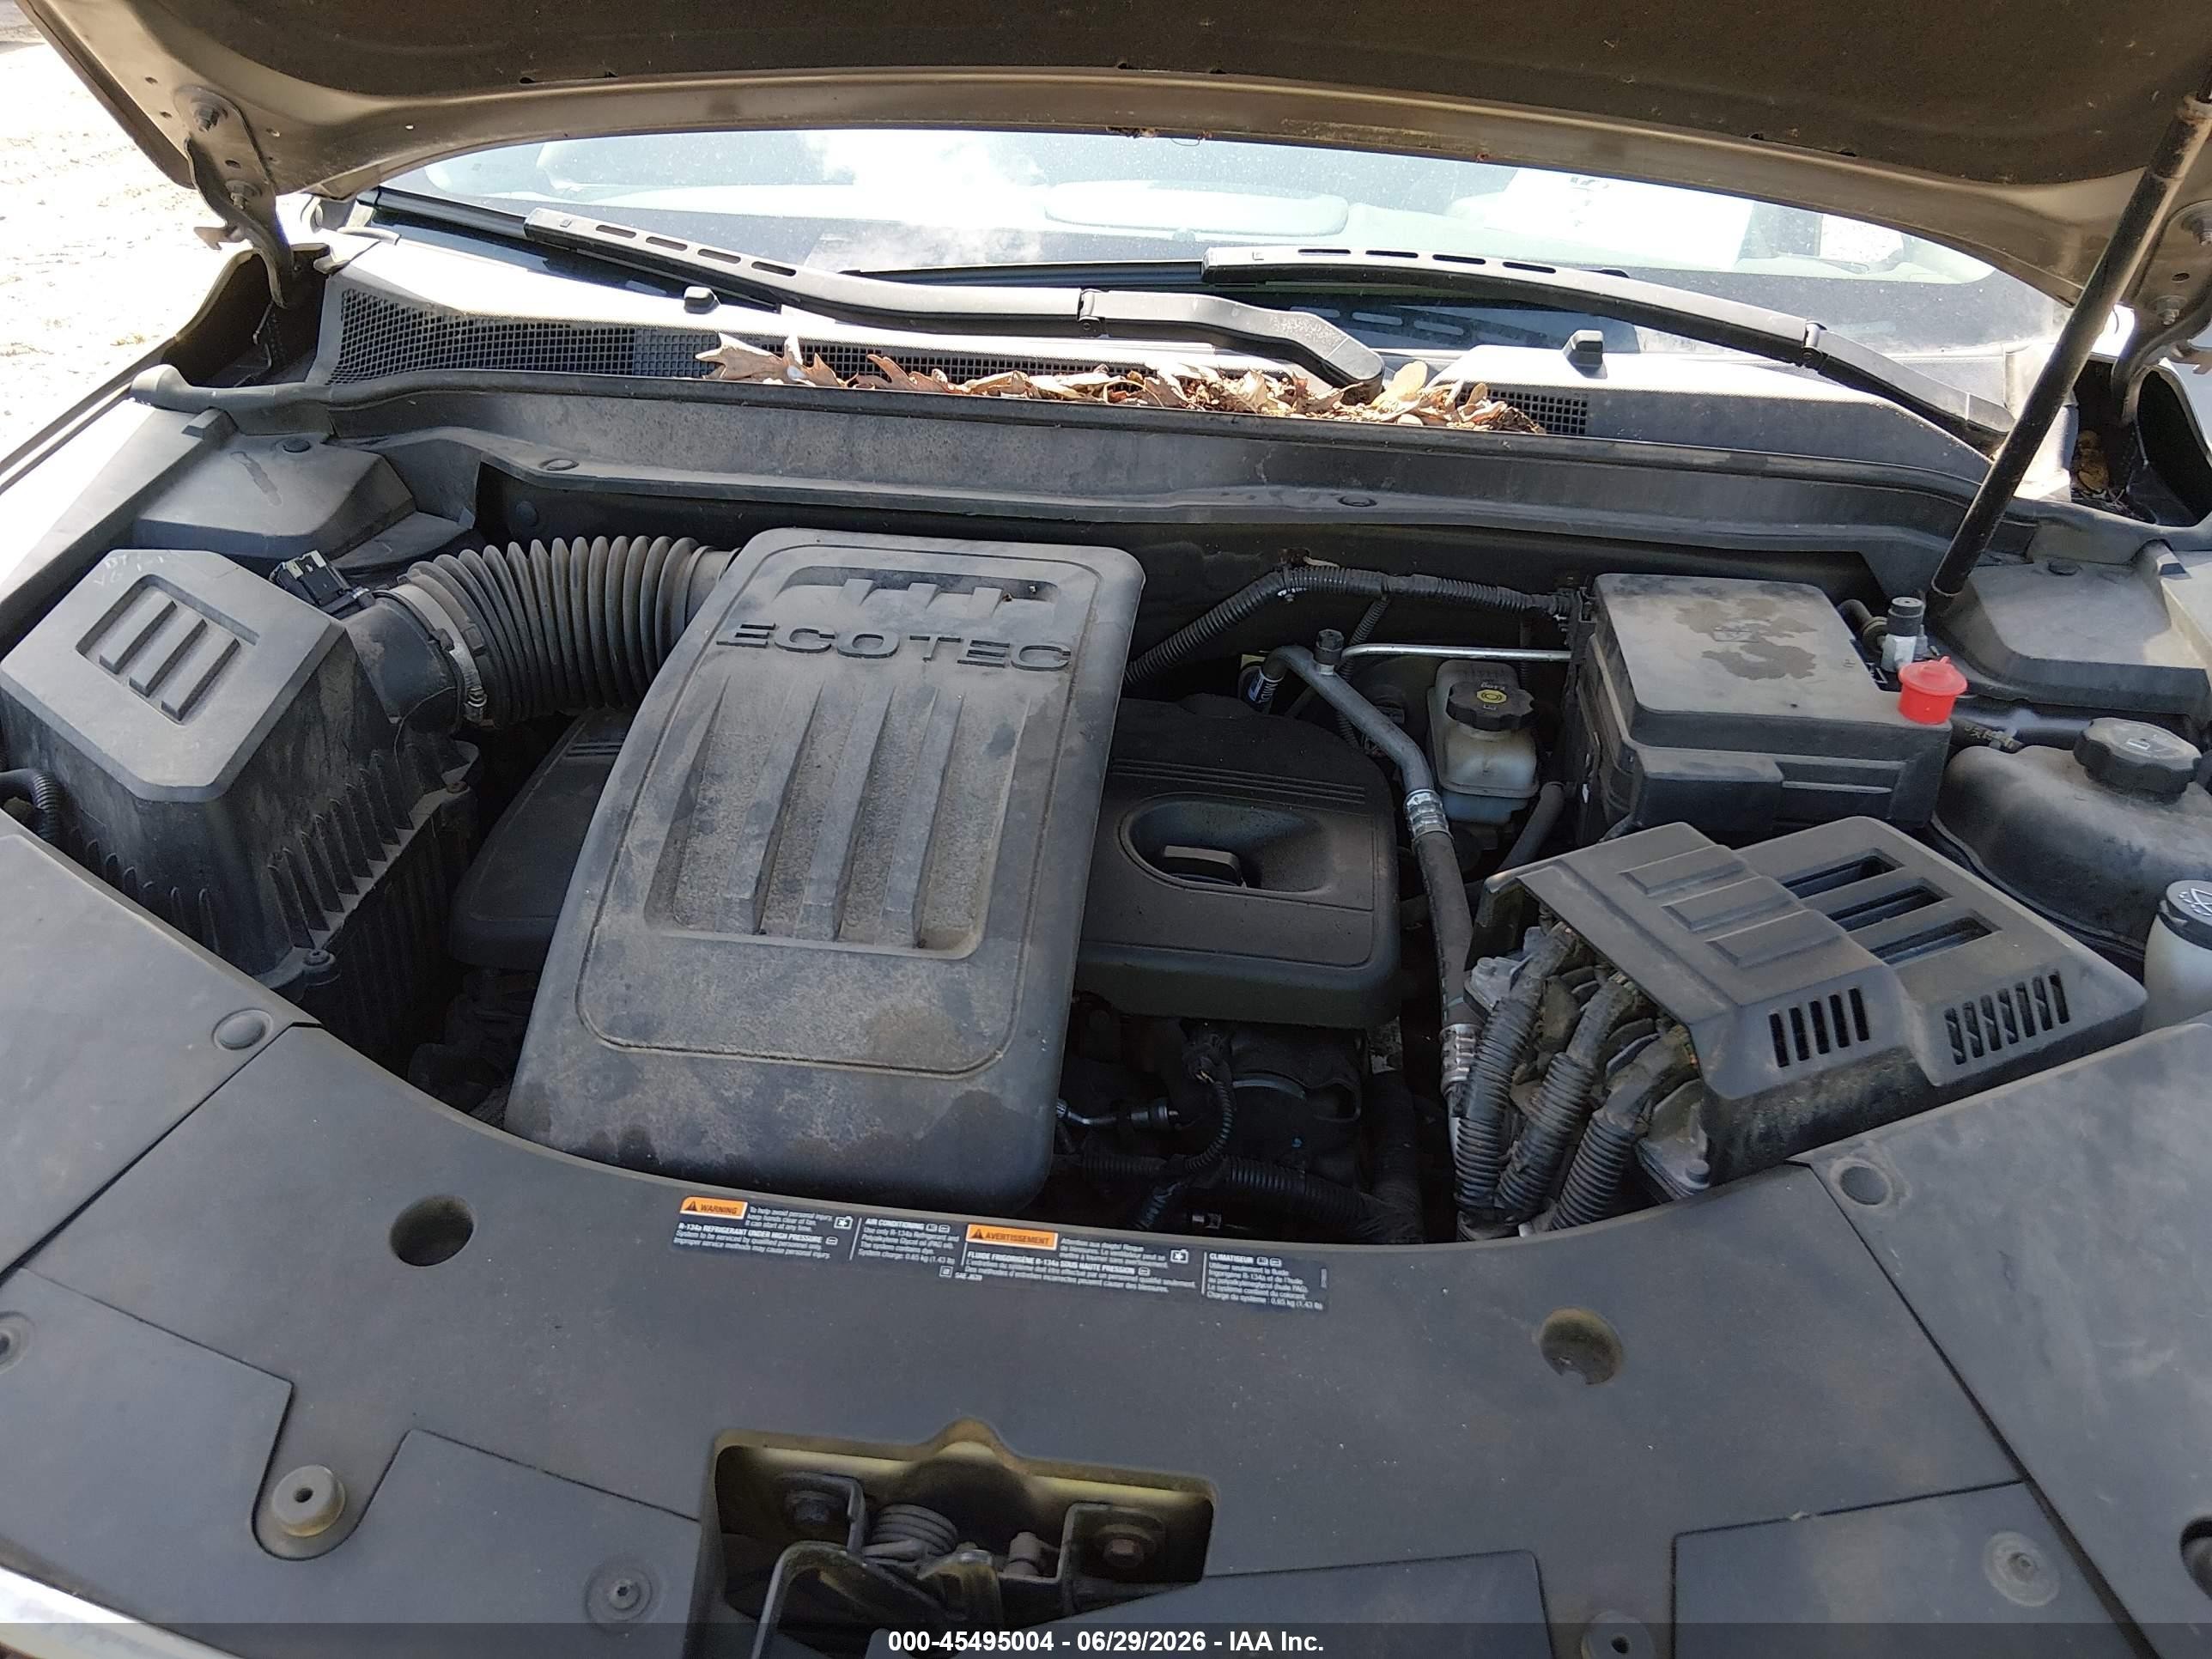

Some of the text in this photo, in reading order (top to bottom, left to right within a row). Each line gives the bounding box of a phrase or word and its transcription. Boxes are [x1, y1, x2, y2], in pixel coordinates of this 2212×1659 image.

[716, 623, 1072, 672] ECOTEC
[701, 1204, 737, 1214] WARNING
[984, 1231, 1049, 1244] AVERTISSEMENT
[1209, 1252, 1254, 1264] CLIMATISEUR
